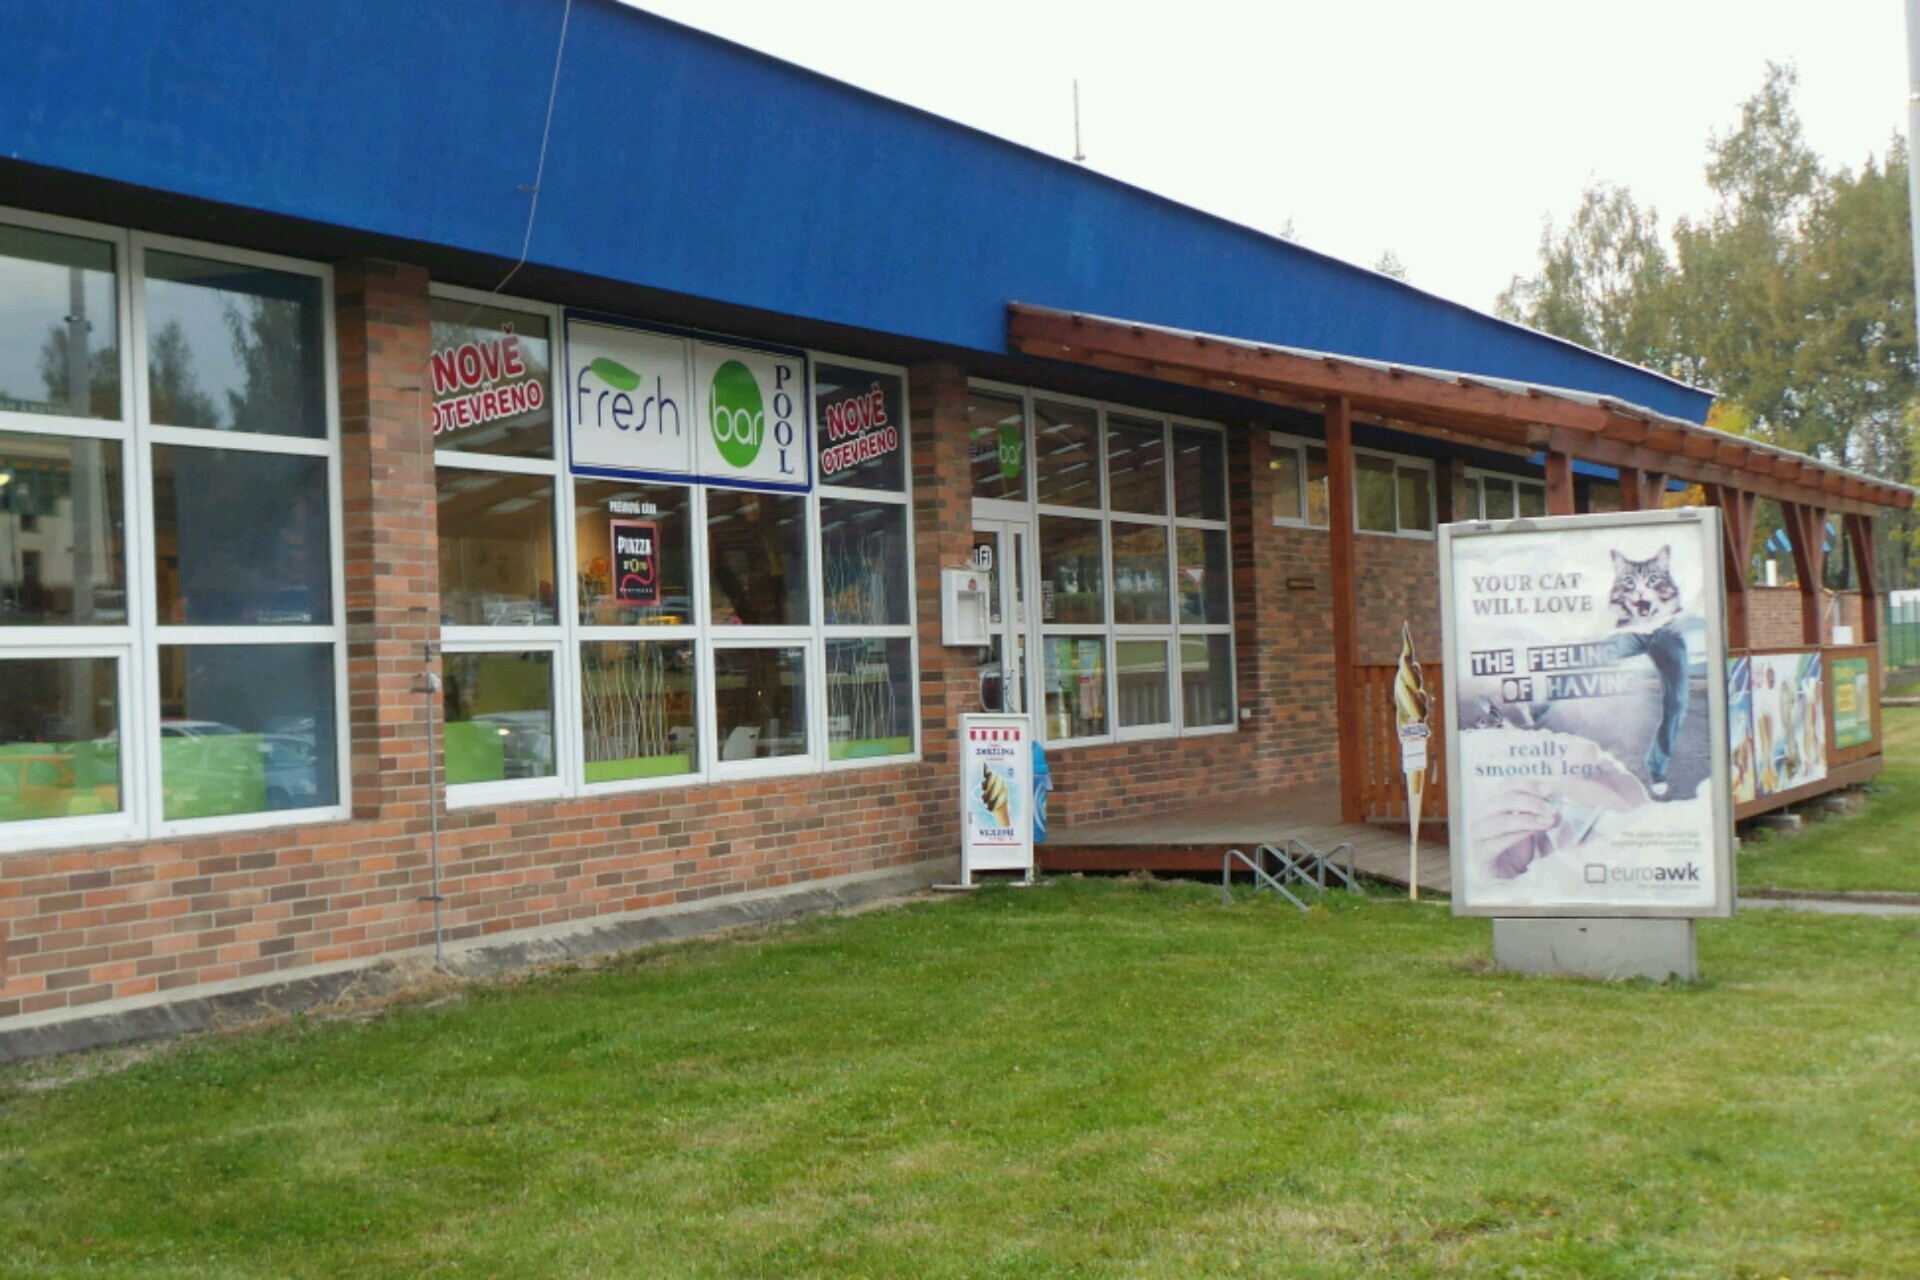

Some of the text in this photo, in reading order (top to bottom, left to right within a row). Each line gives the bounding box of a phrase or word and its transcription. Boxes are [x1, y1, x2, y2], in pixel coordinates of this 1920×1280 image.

[578, 364, 680, 436] fresh
[712, 384, 764, 446] bar
[773, 365, 794, 475] POOL
[1471, 572, 1582, 593] YOUR CAT
[1472, 595, 1593, 615] WILL LOVE
[1471, 643, 1618, 675] THE FEELING
[1502, 678, 1532, 702] OF
[1509, 740, 1569, 757] really
[1475, 761, 1553, 777] smooth
[1610, 861, 1700, 881] euroawk
